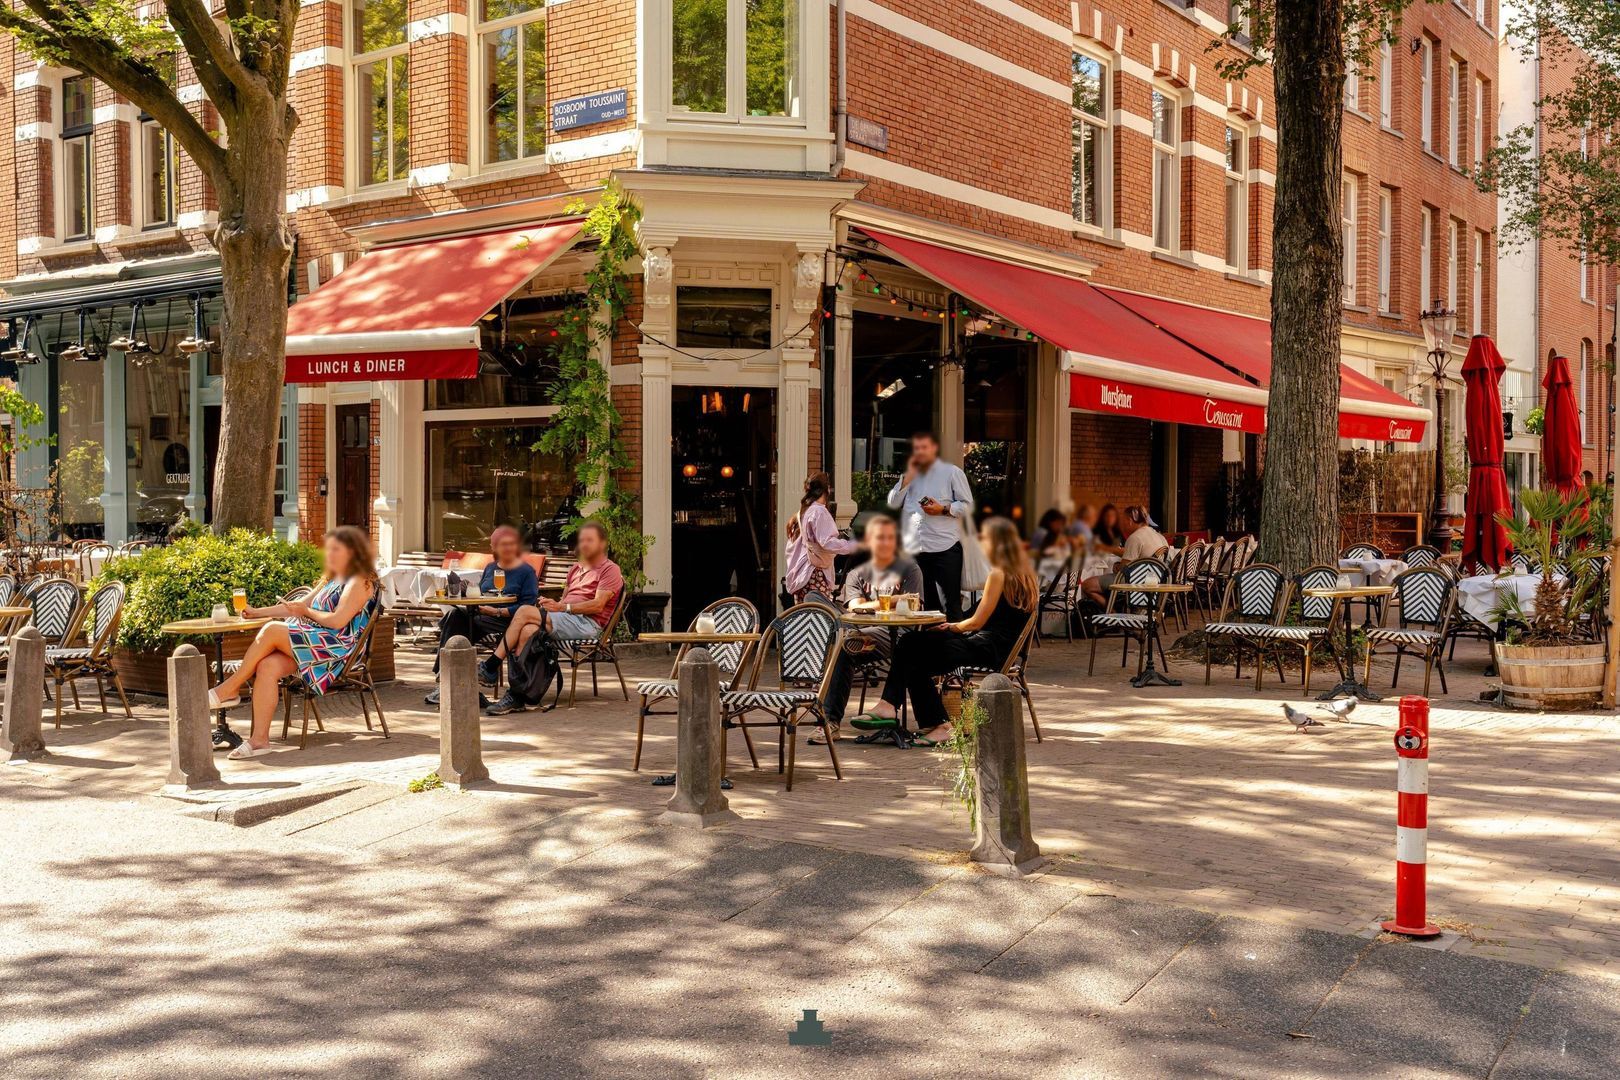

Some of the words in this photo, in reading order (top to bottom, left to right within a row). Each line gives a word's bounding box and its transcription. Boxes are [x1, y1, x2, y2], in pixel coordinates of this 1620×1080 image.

[554, 100, 587, 116] BOSBOOM
[589, 92, 626, 109] TOUSSAINT
[600, 108, 625, 119] OUD-WEST
[554, 114, 578, 128] STRAAT
[308, 361, 349, 375] LUNCH
[353, 360, 361, 374] &
[366, 358, 406, 373] DINER
[1101, 383, 1133, 410] Warsteiner
[1203, 398, 1244, 428] Toussaint
